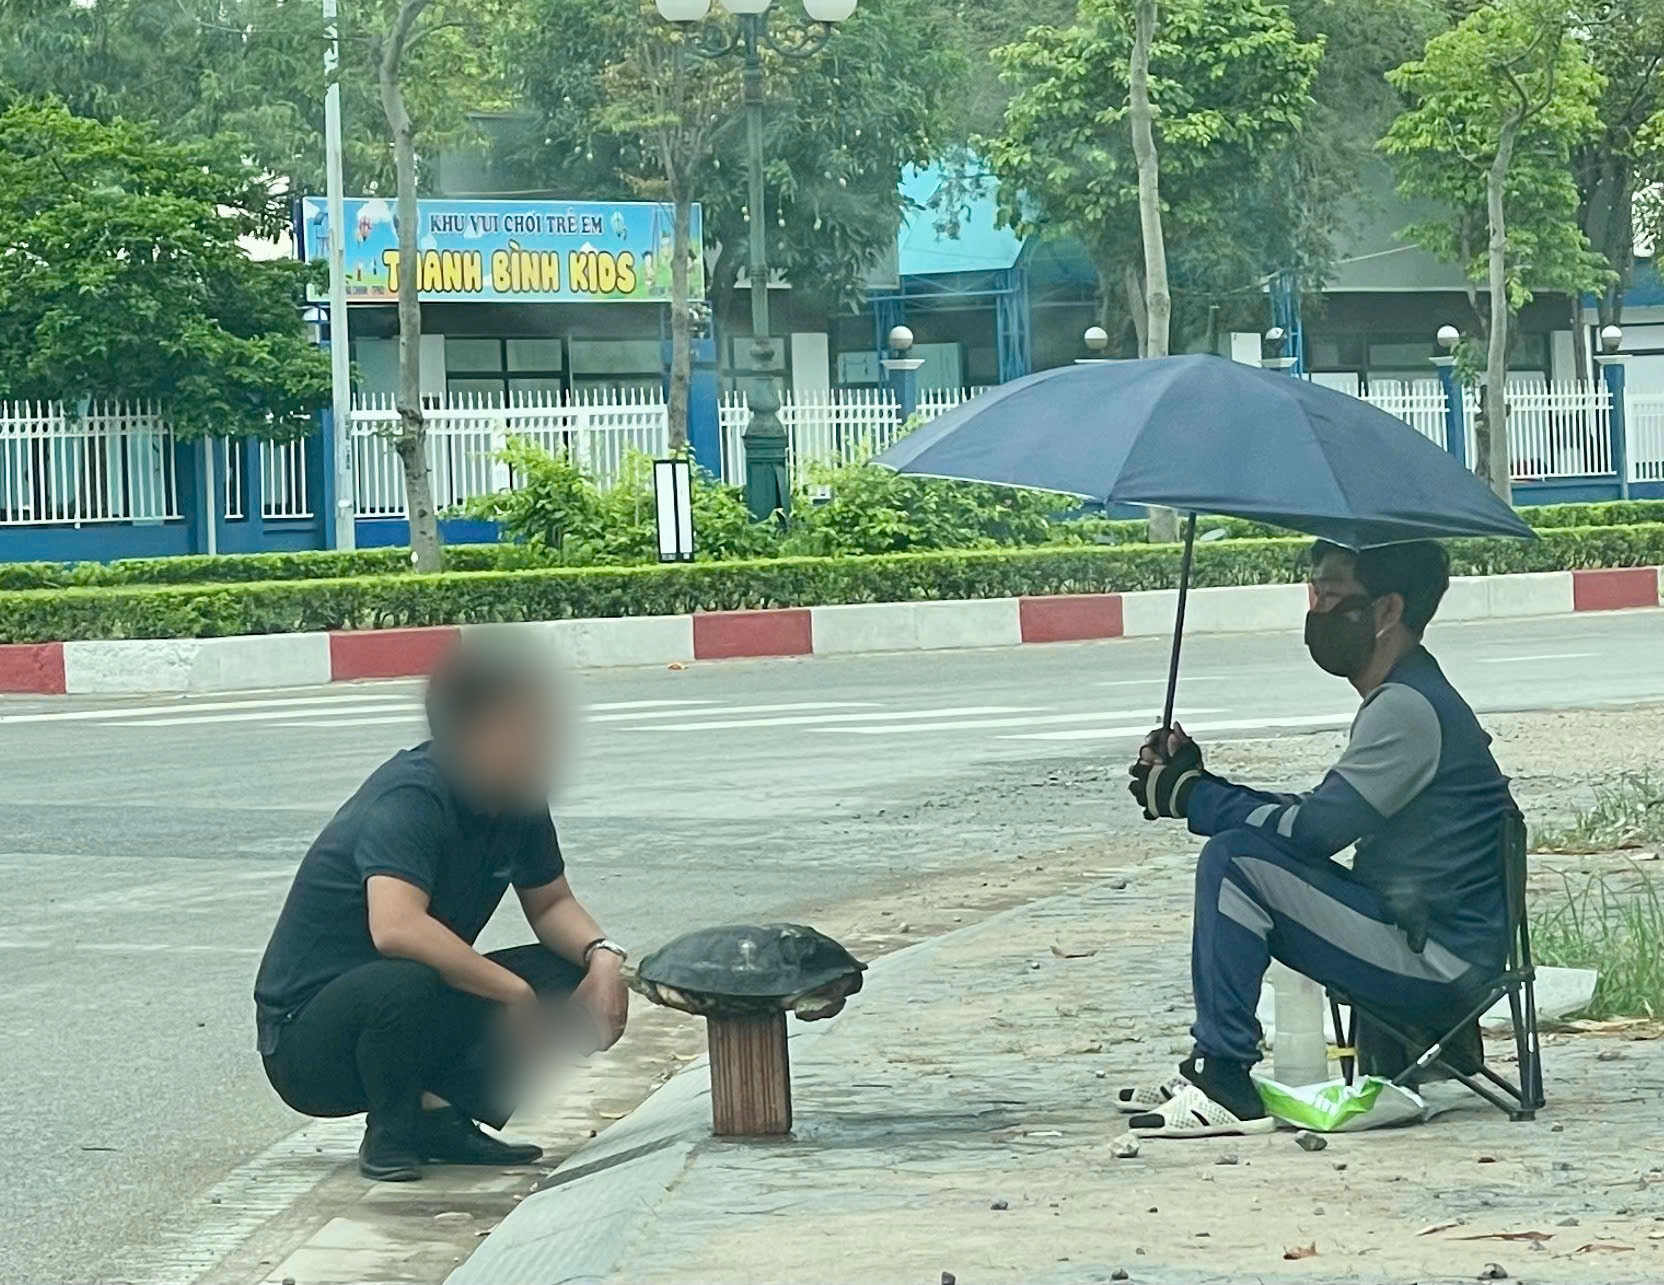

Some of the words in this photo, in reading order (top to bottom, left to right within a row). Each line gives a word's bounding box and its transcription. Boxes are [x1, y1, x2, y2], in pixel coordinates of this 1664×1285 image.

[431, 215, 465, 232] KHU
[471, 215, 498, 232] VUI
[581, 216, 602, 233] EM
[491, 239, 560, 293] BÌNH
[568, 250, 636, 294] KIDS
